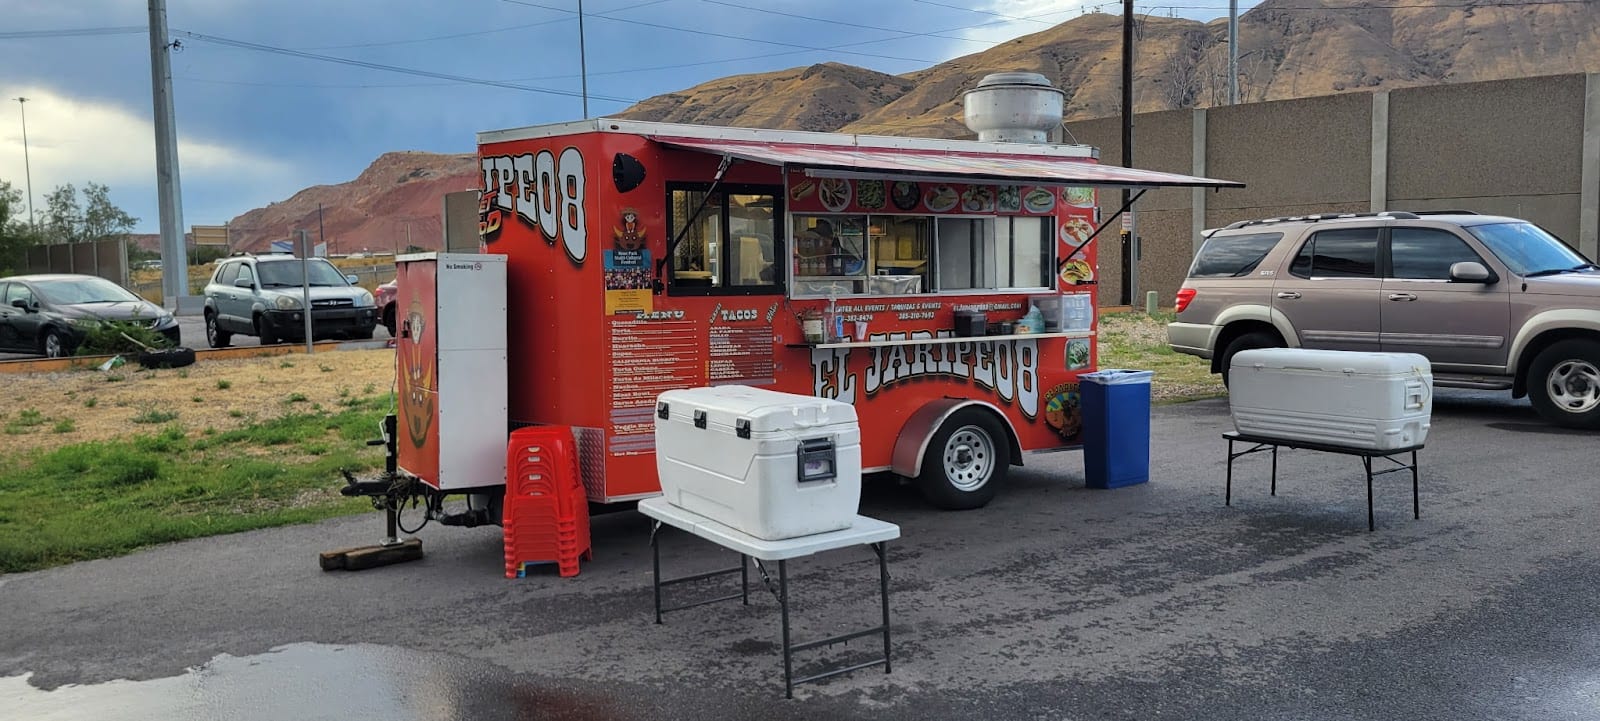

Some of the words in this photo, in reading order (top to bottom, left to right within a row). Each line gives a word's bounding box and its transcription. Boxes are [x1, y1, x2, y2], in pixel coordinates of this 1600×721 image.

[480, 147, 587, 263] IPEO8
[853, 304, 864, 312] ALL
[865, 304, 886, 312] EVENTS
[635, 310, 685, 320] MENU
[721, 309, 758, 321] TACOS
[810, 336, 857, 405] EL
